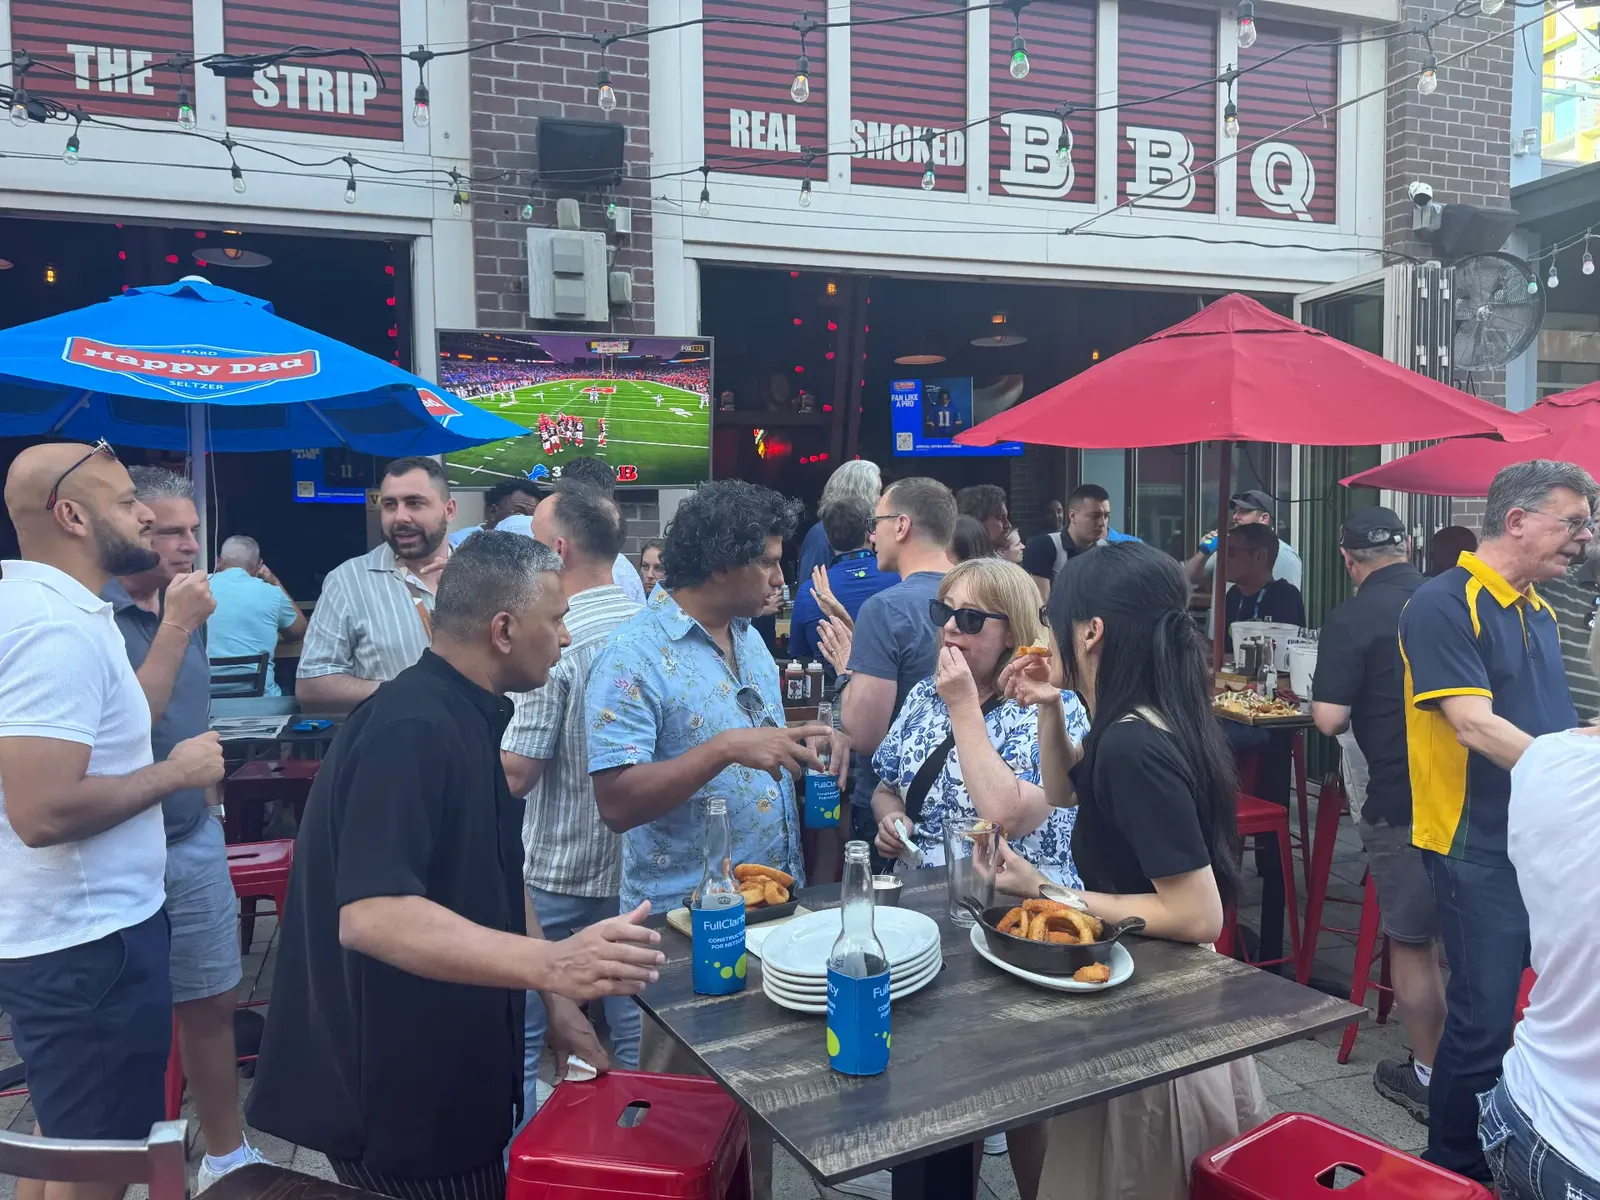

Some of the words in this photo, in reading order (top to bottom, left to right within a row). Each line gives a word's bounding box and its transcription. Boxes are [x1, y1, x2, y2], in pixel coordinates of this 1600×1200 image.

[66, 44, 154, 96] THE
[251, 64, 377, 116] STRIP
[730, 108, 801, 153] REAL
[850, 120, 965, 167] SMOKED
[82, 347, 221, 376] Happy
[229, 358, 304, 374] Dad
[169, 380, 224, 390] SELTZER
[938, 411, 950, 426] 11
